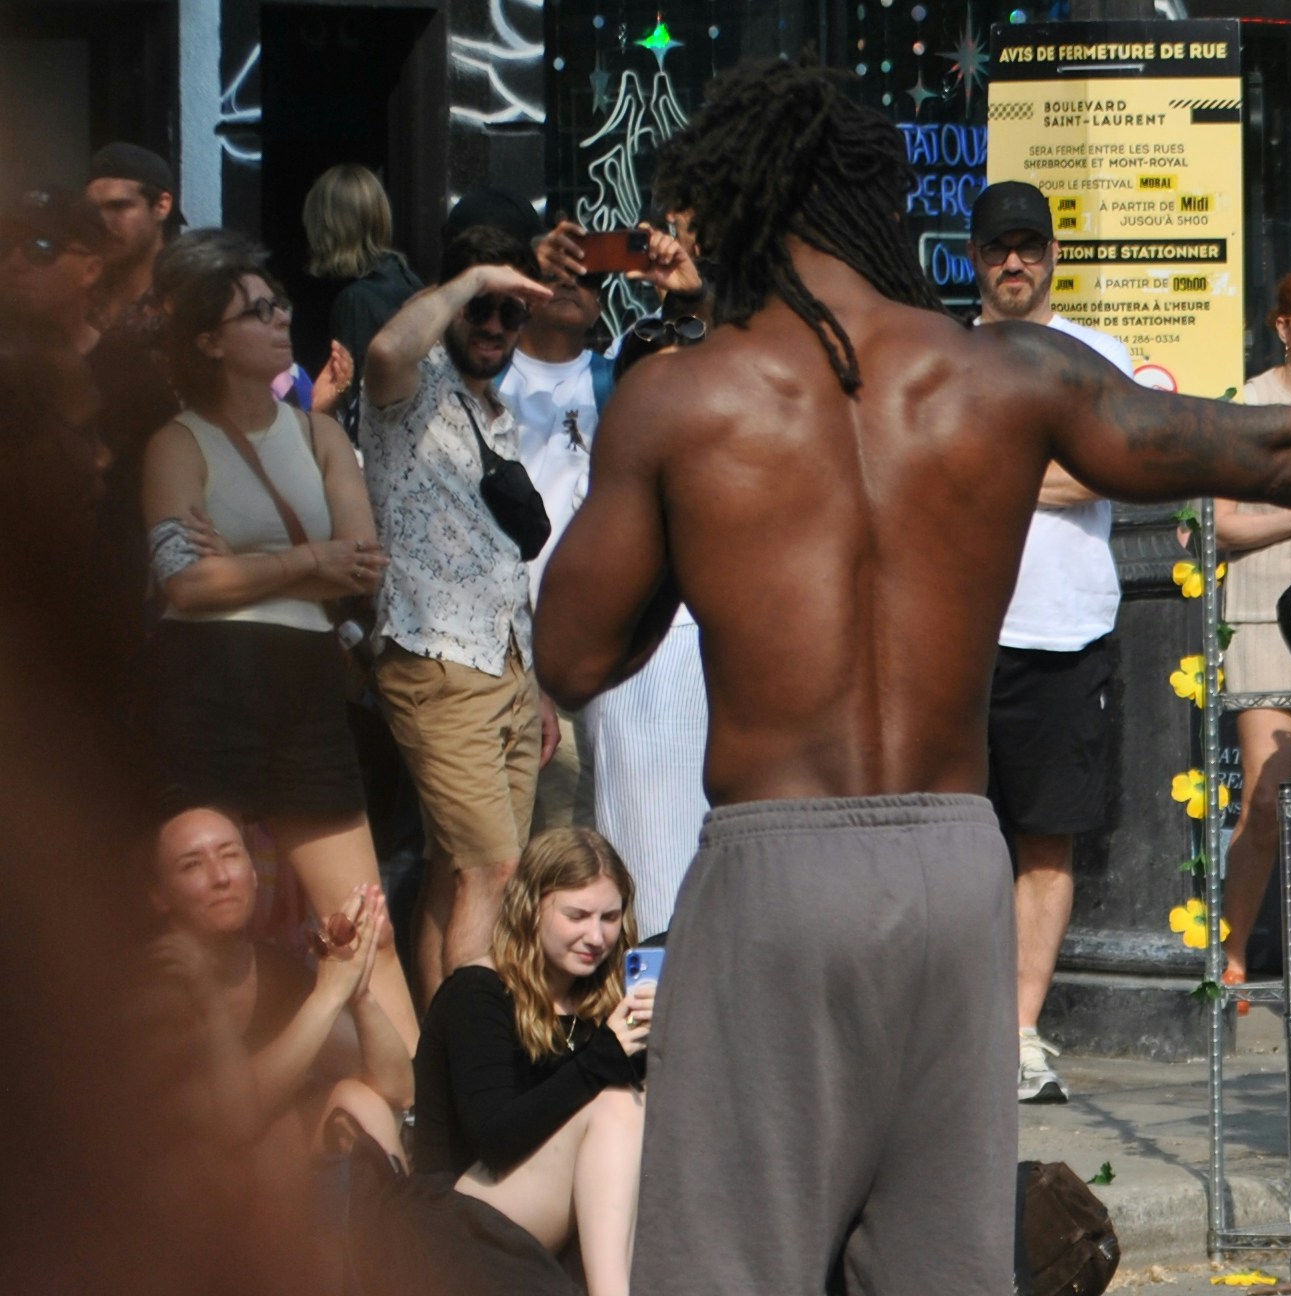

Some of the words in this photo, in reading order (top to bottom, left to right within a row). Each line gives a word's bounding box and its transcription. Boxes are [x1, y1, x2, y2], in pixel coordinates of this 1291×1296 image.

[999, 47, 1032, 63] AVIS
[1036, 45, 1055, 62] DE
[1059, 42, 1155, 61] FERMETURE
[1160, 42, 1184, 59] DE
[1189, 42, 1228, 59] RUE
[1044, 100, 1127, 113] BOULEVARD
[1043, 114, 1166, 127] SAINT-LAURENT
[1029, 146, 1054, 157] SERA
[1056, 143, 1086, 155] FERMÉ
[1088, 145, 1126, 155] ENTRE
[1128, 144, 1150, 154] LES
[1153, 143, 1185, 154] RUES
[1023, 158, 1087, 170] SHERBROOKE
[1091, 158, 1104, 168] ET
[1108, 157, 1189, 168] MONT-ROYAL
[1039, 180, 1065, 190] POUR
[1067, 180, 1080, 189] LE
[1081, 179, 1133, 189] FESTIVAL
[1138, 177, 1172, 189] MURAL
[1099, 200, 1109, 211] À
[1111, 201, 1156, 212] PARTIR
[1160, 201, 1175, 211] DE
[1180, 196, 1209, 212] Midi
[1120, 214, 1174, 226] JUSQU'À
[1177, 215, 1209, 226] 5H00
[1097, 246, 1116, 260] DE
[1120, 244, 1219, 260] STATIONNER
[1094, 275, 1102, 289] À
[1106, 277, 1150, 289] PARTIR
[1153, 277, 1169, 289] DE
[1173, 277, 1207, 291] 09h00
[1091, 300, 1150, 312] DÉBUTERA
[1153, 300, 1160, 311] À
[1164, 301, 1210, 311] L'HEURE
[1104, 316, 1119, 326] DE
[1122, 316, 1196, 326] STATIONNER
[1132, 334, 1180, 344] 286-0334
